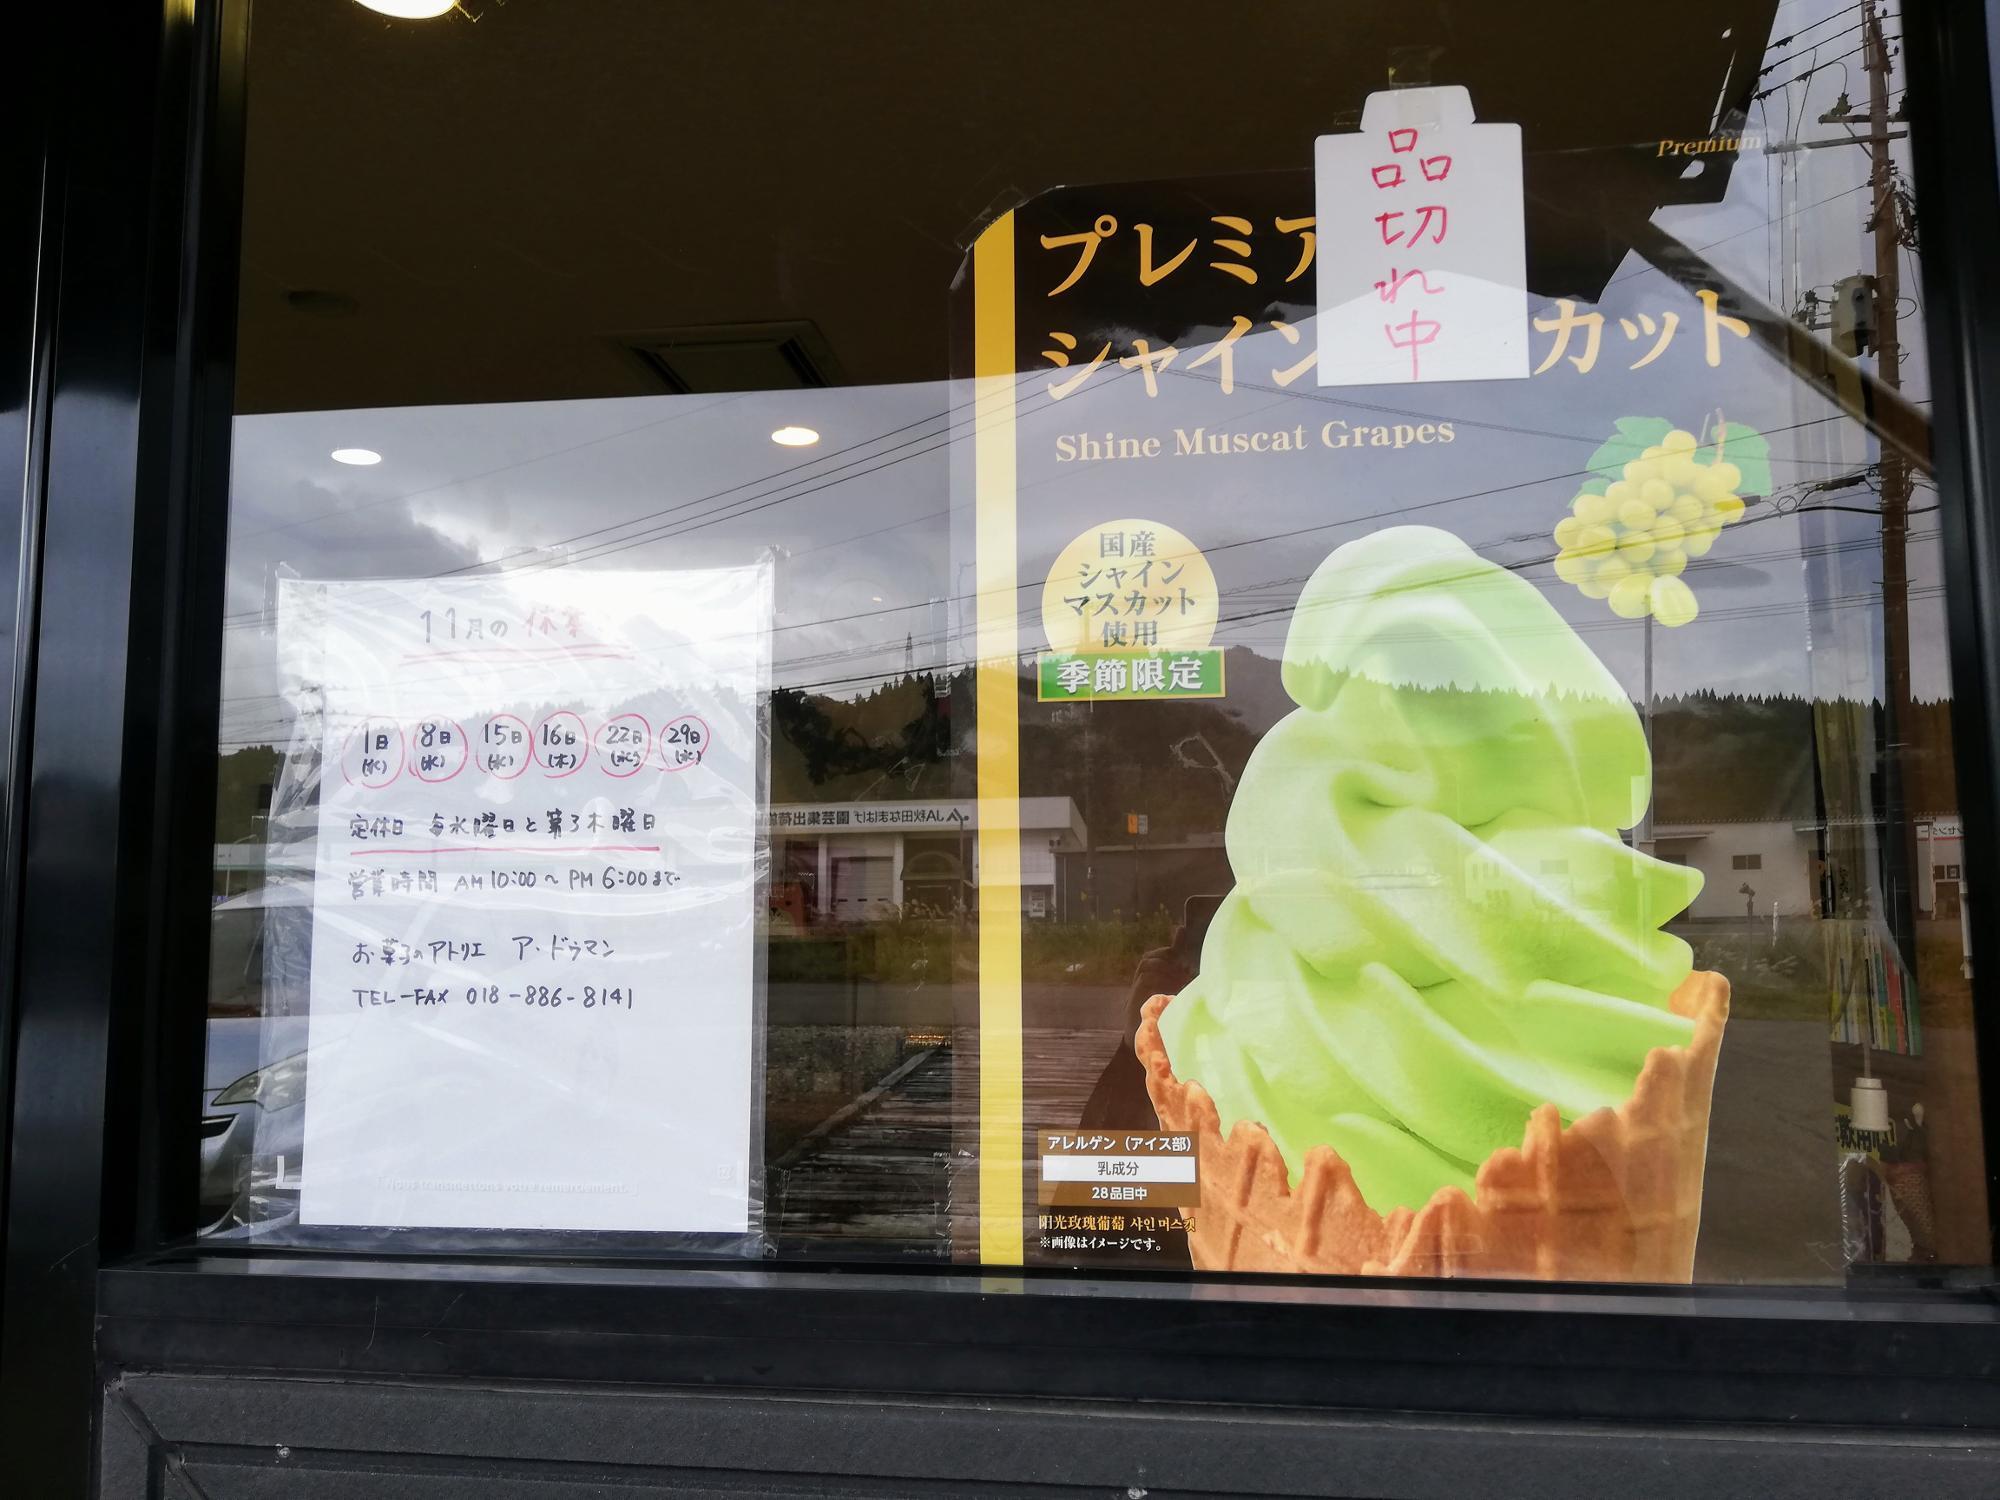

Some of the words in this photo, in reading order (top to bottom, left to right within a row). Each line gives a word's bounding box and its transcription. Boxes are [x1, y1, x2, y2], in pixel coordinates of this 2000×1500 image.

[1656, 136, 1761, 158] Premium
[1040, 213, 1317, 297] プレミア
[1371, 127, 1453, 381] 品切れ中
[1056, 432, 1162, 463] Shine
[1173, 424, 1309, 456] Muscat
[1321, 418, 1457, 449] Grapes
[1099, 530, 1157, 559] 国産
[1077, 560, 1185, 590] シャイン
[1063, 587, 1196, 617] マスカット
[1101, 620, 1159, 648] 使用
[1056, 656, 1204, 694] 季節限定
[420, 725, 451, 749] 8日
[484, 723, 523, 746] 15日
[542, 723, 577, 746] 16日
[606, 725, 643, 746] 22日
[667, 723, 701, 745] 29日
[349, 814, 405, 839] 定休日
[349, 868, 438, 900] 営業時間
[454, 875, 483, 891] AM
[490, 869, 537, 888] 10:00
[569, 869, 593, 888] PM
[1097, 1160, 1140, 1177] 乳成分
[1091, 1186, 1148, 1201] 28品目中
[1039, 1235, 1163, 1252] ※画像はイメージです。
